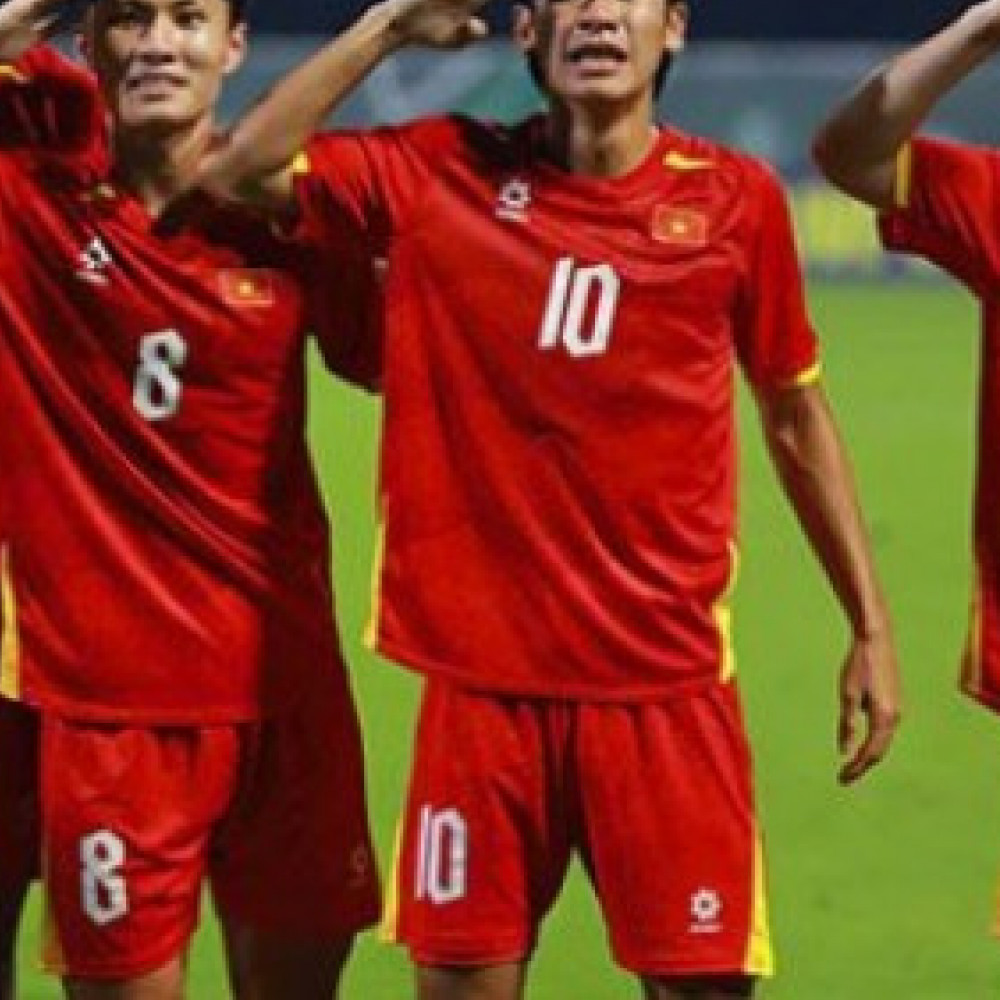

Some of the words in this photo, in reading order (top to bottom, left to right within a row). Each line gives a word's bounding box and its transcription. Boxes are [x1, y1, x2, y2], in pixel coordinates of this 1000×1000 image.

[538, 256, 620, 358] 10
[133, 328, 186, 420] 8
[79, 828, 130, 925] 8
[414, 804, 467, 904] 10
